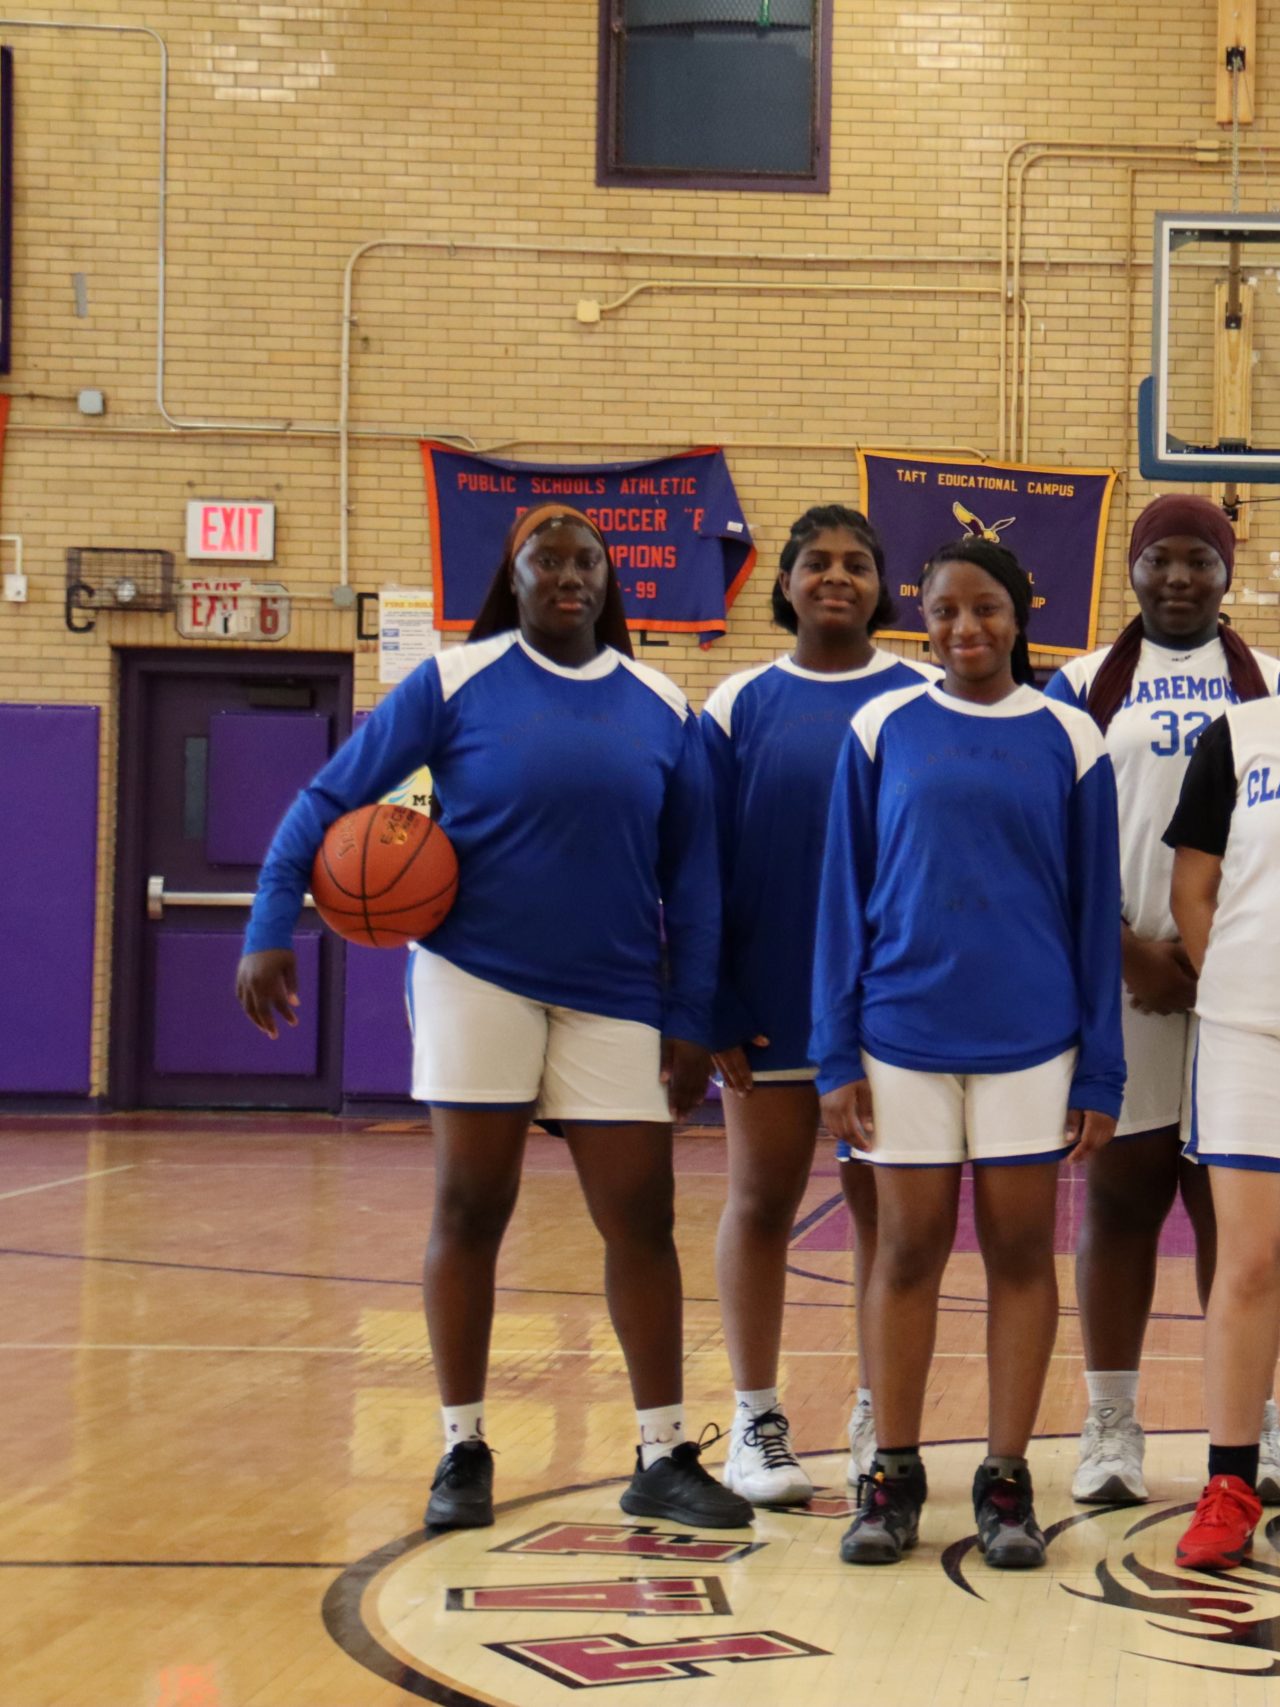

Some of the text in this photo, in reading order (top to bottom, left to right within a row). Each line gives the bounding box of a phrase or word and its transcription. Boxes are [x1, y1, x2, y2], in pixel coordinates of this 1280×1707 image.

[457, 472, 697, 495] PUBLIC SCHOOLS ATHLETIC
[897, 469, 1075, 497] TAFT EDUCATIONAL CAMPUS
[201, 507, 263, 552] EXIT
[586, 508, 668, 532] SOCCER
[1150, 710, 1212, 758] 32
